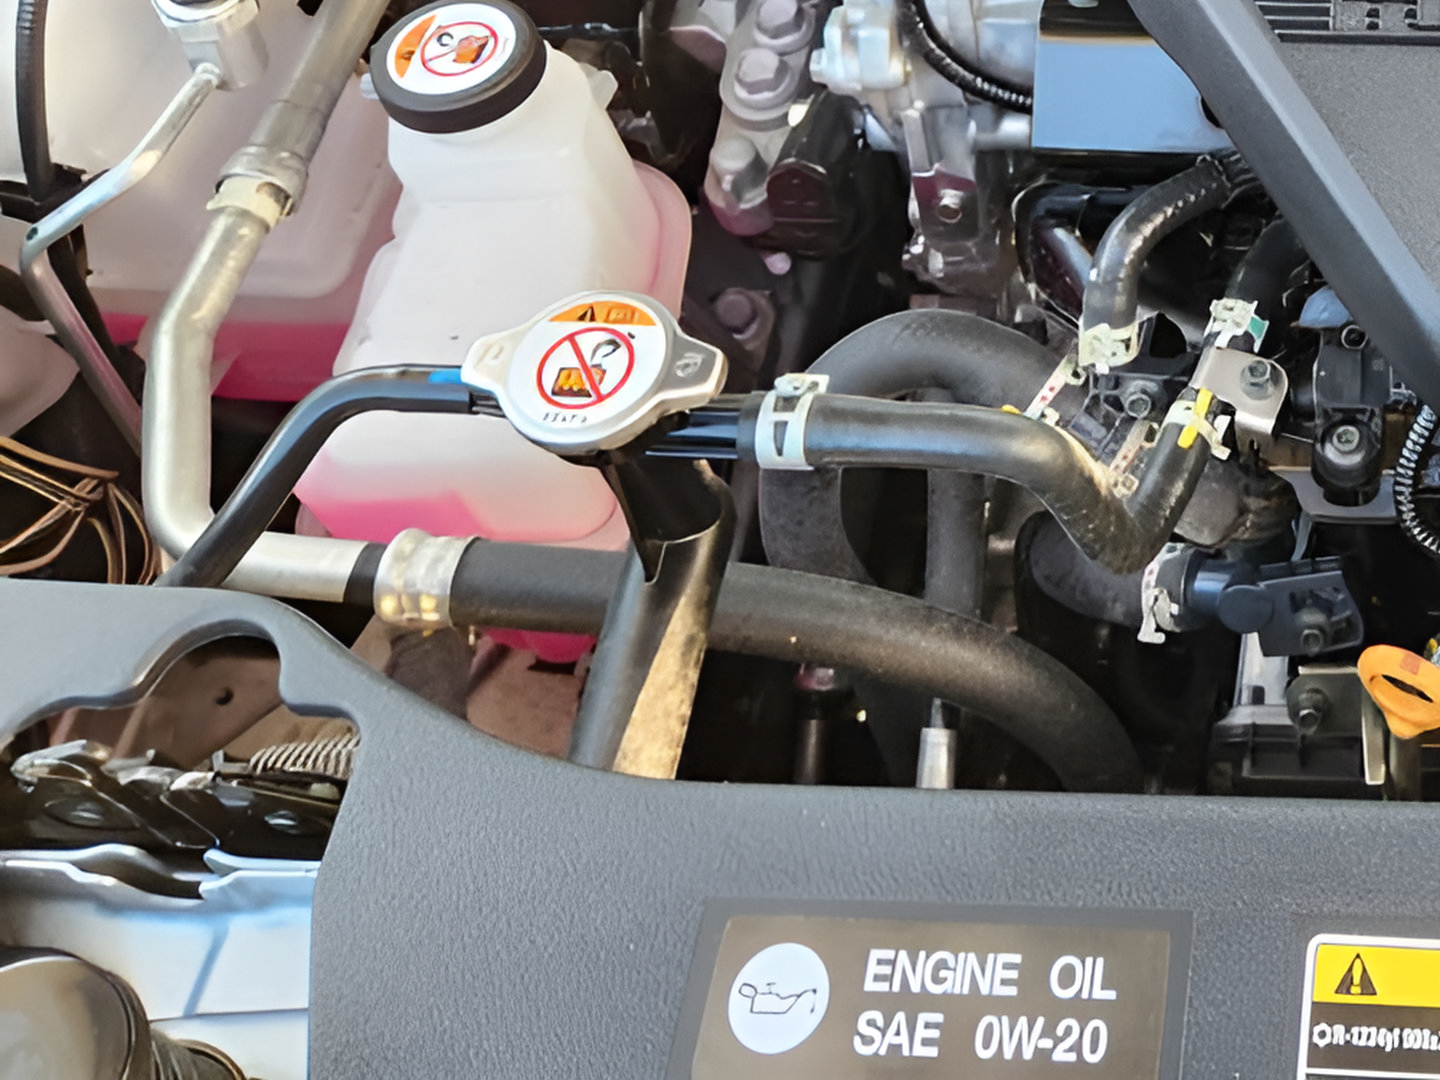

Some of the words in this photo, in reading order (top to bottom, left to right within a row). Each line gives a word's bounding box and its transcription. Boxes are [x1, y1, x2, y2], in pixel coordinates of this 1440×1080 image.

[863, 948, 1022, 997] ENGINE
[1049, 954, 1118, 1001] OIL
[853, 1009, 945, 1058] SAE
[974, 1014, 1109, 1064] 0W-20
